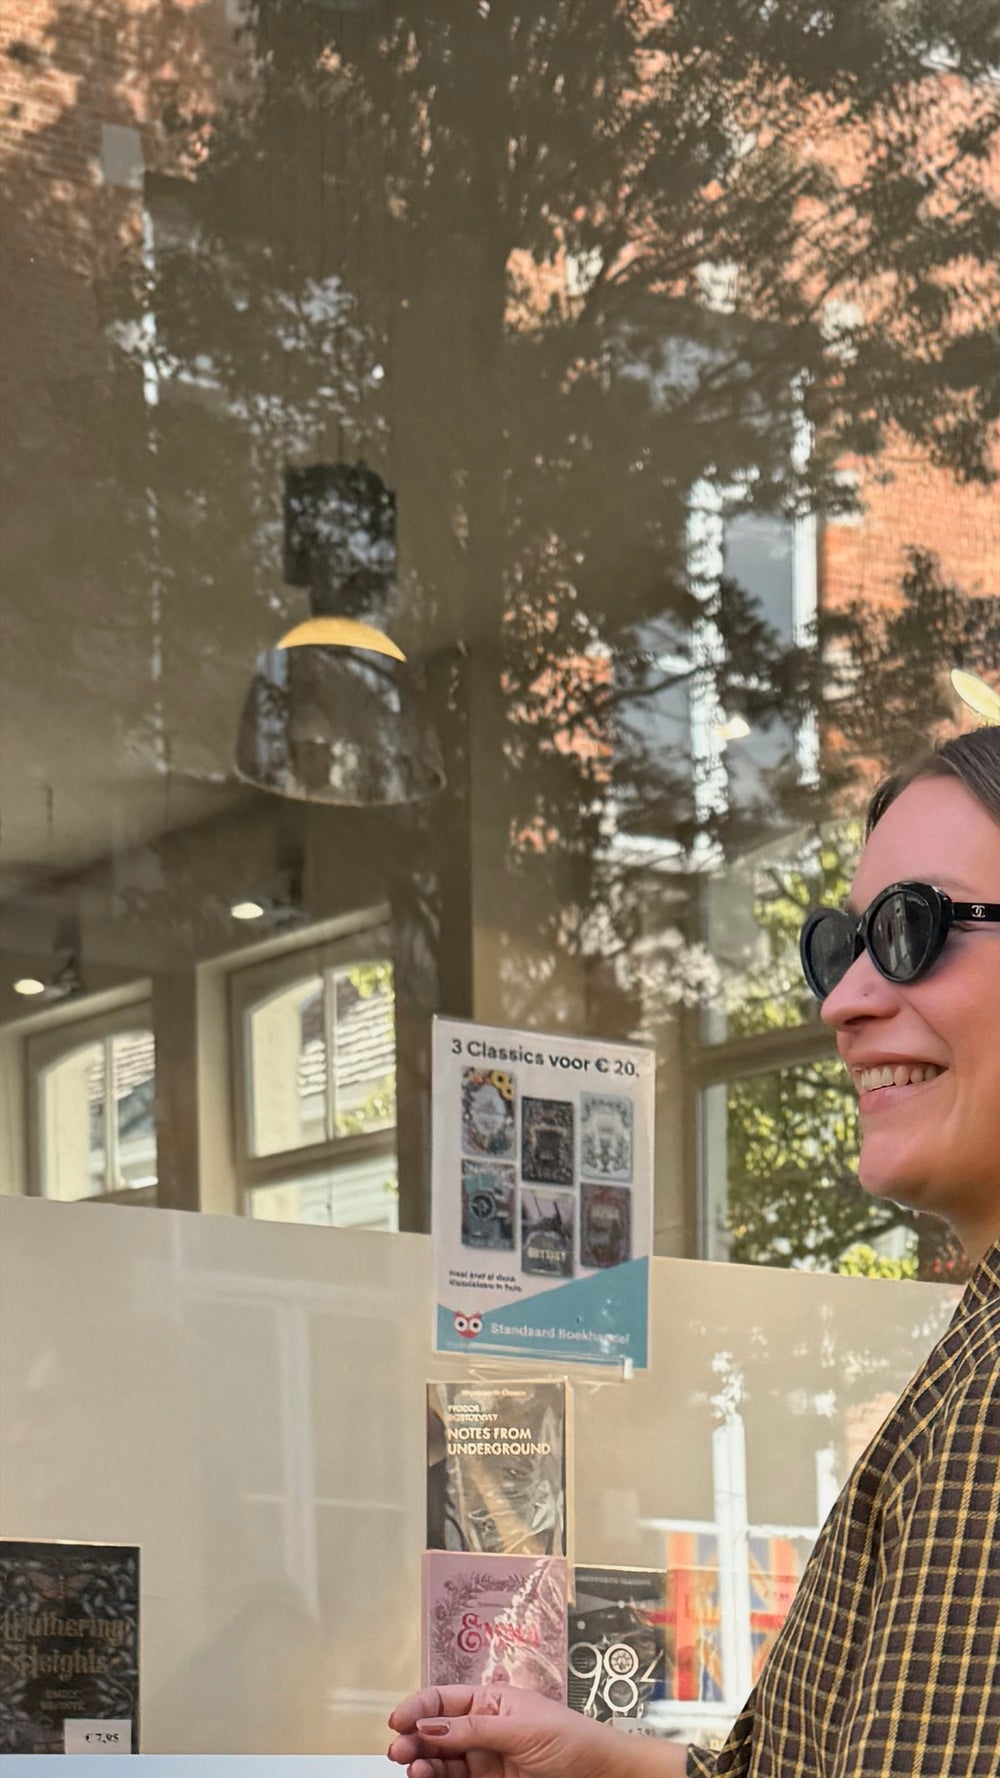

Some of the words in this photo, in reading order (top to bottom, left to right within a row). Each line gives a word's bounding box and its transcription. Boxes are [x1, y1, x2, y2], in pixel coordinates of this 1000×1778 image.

[451, 1038, 463, 1055] 3
[467, 1041, 545, 1066] Classics
[549, 1054, 591, 1072] voor
[595, 1058, 609, 1074] €
[490, 1322, 555, 1339] Standaard
[447, 1427, 491, 1440] NOTES
[493, 1427, 532, 1440] FROM
[447, 1442, 551, 1456] UNDERGROUND
